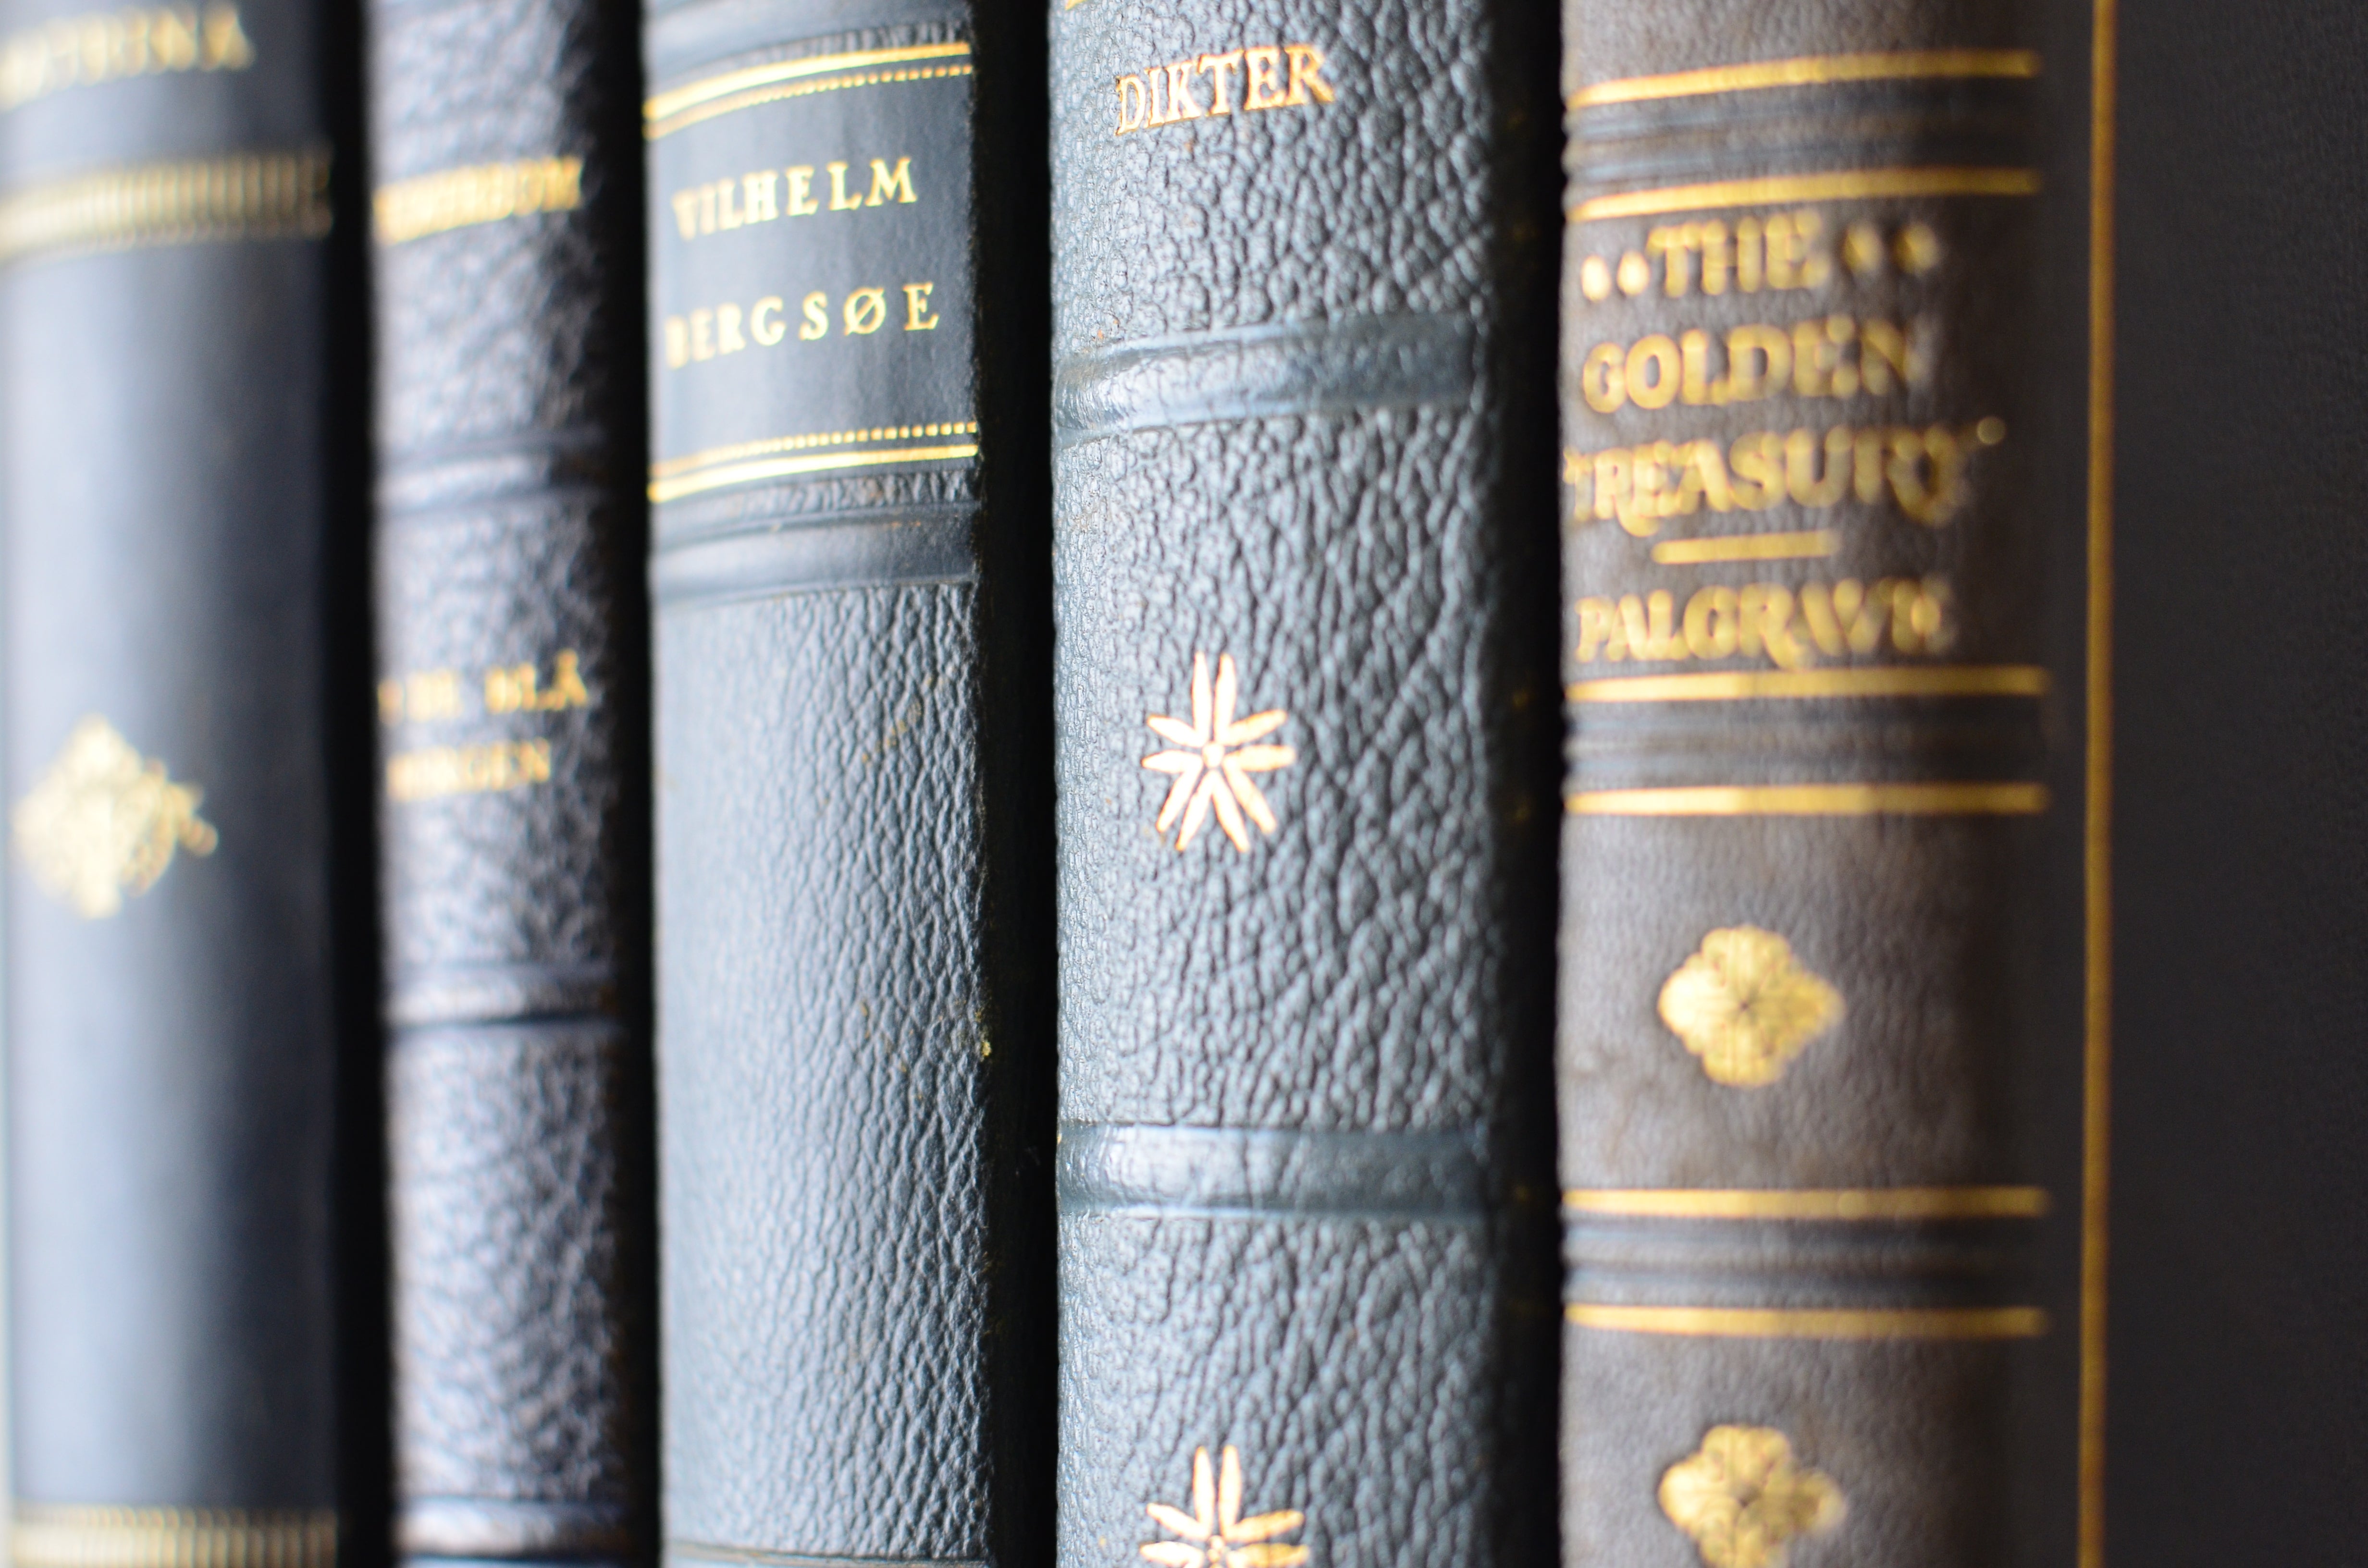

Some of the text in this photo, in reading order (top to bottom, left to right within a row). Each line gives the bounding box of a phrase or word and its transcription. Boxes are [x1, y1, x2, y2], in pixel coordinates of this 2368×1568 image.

[1115, 44, 1335, 136] DIKTER
[673, 156, 918, 242] VILHELM
[1645, 210, 1832, 298] THE
[665, 282, 940, 370] BERGSØE
[1582, 315, 1936, 414] GOLDEN
[1563, 417, 2005, 537] TREASURY
